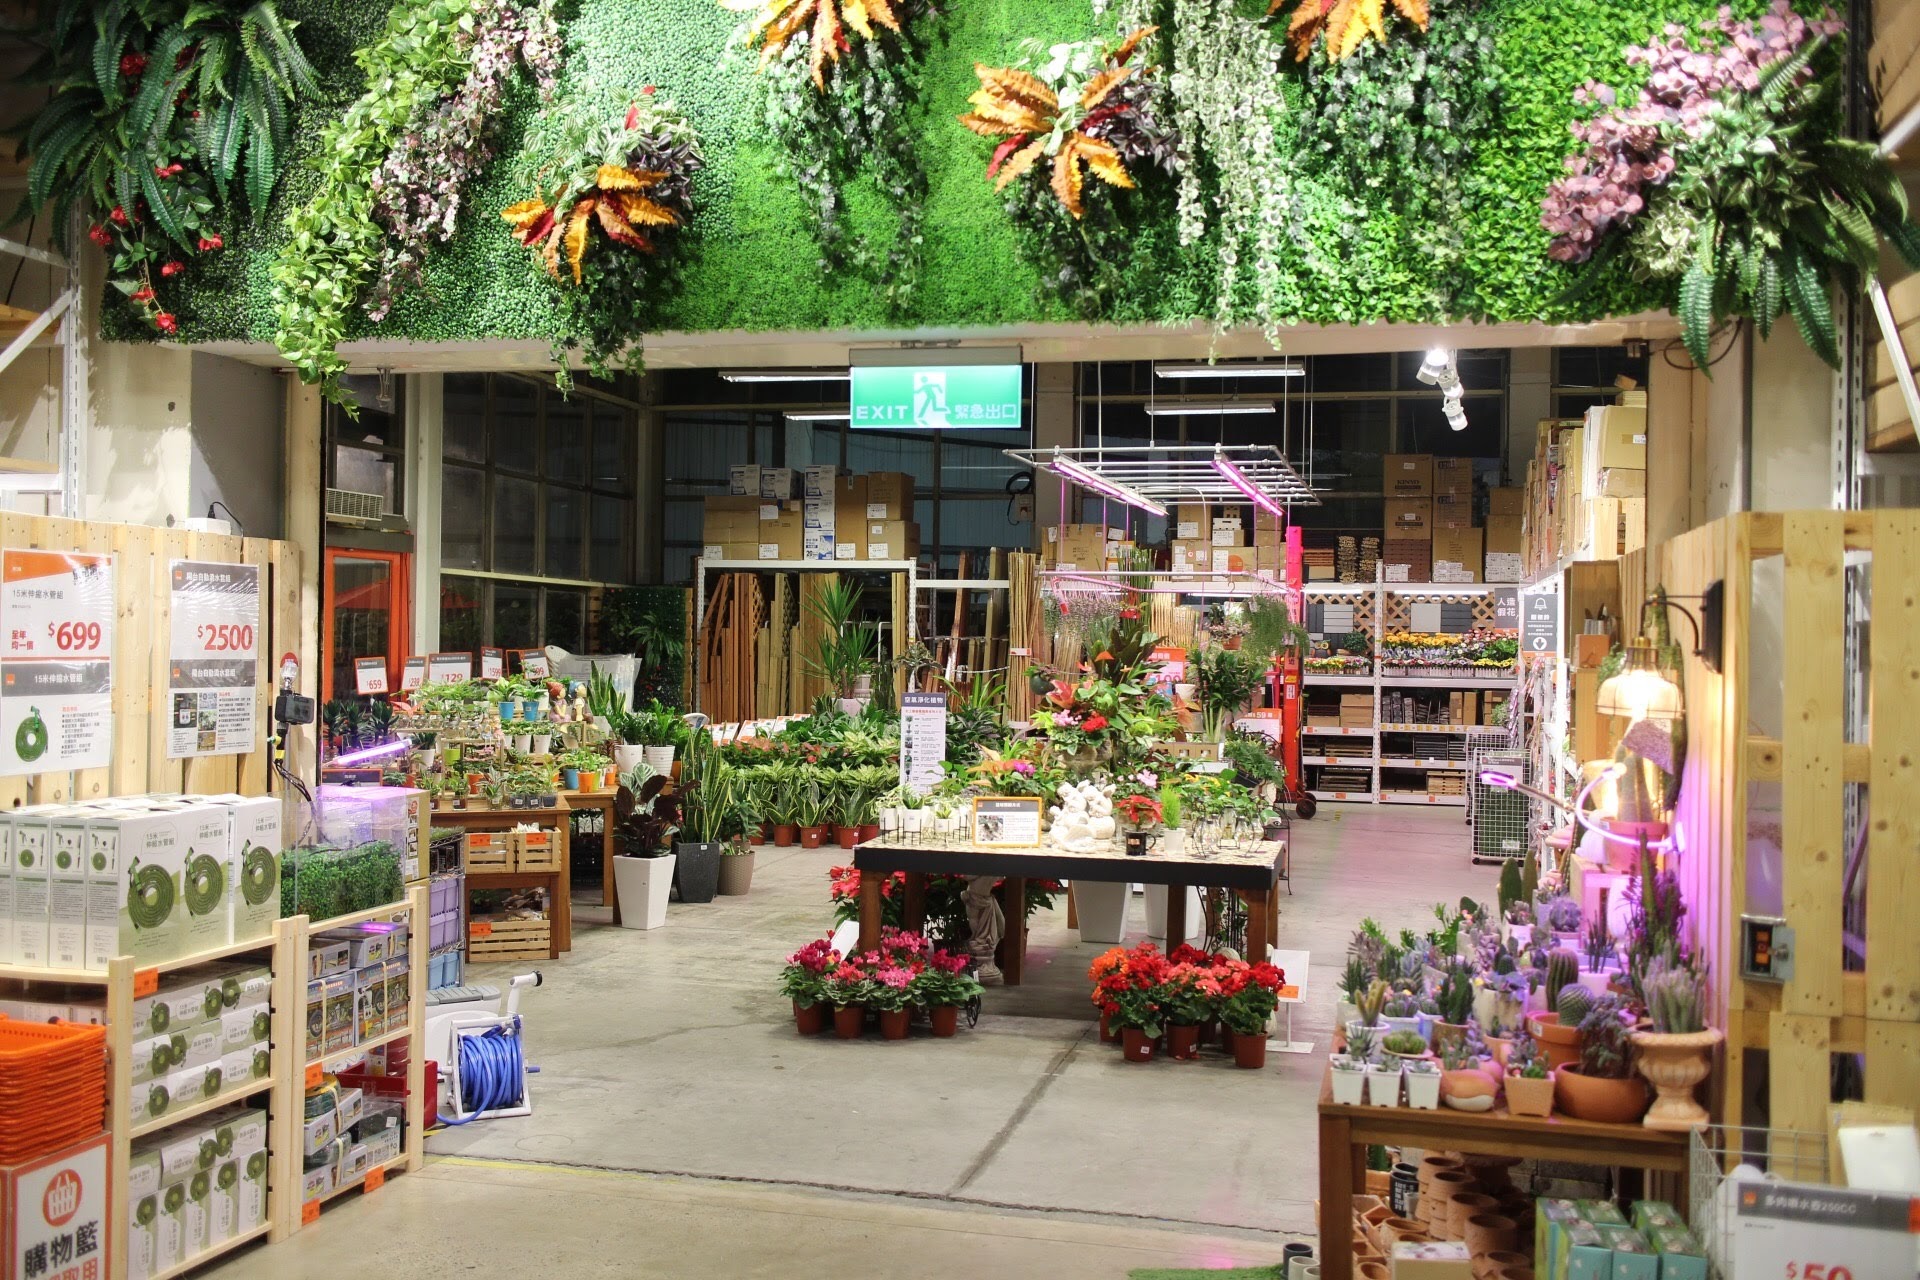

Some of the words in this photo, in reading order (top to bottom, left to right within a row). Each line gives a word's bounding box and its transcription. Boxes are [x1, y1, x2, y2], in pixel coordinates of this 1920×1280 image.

[856, 405, 909, 420] EXIT
[954, 403, 1017, 420] 緊急出口
[11, 629, 28, 640] 全年
[47, 621, 102, 651] $699
[197, 623, 253, 651] $2500
[11, 640, 34, 651] 均一價
[904, 696, 944, 704] 空氣淨化植物
[24, 1220, 98, 1280] 購物籃
